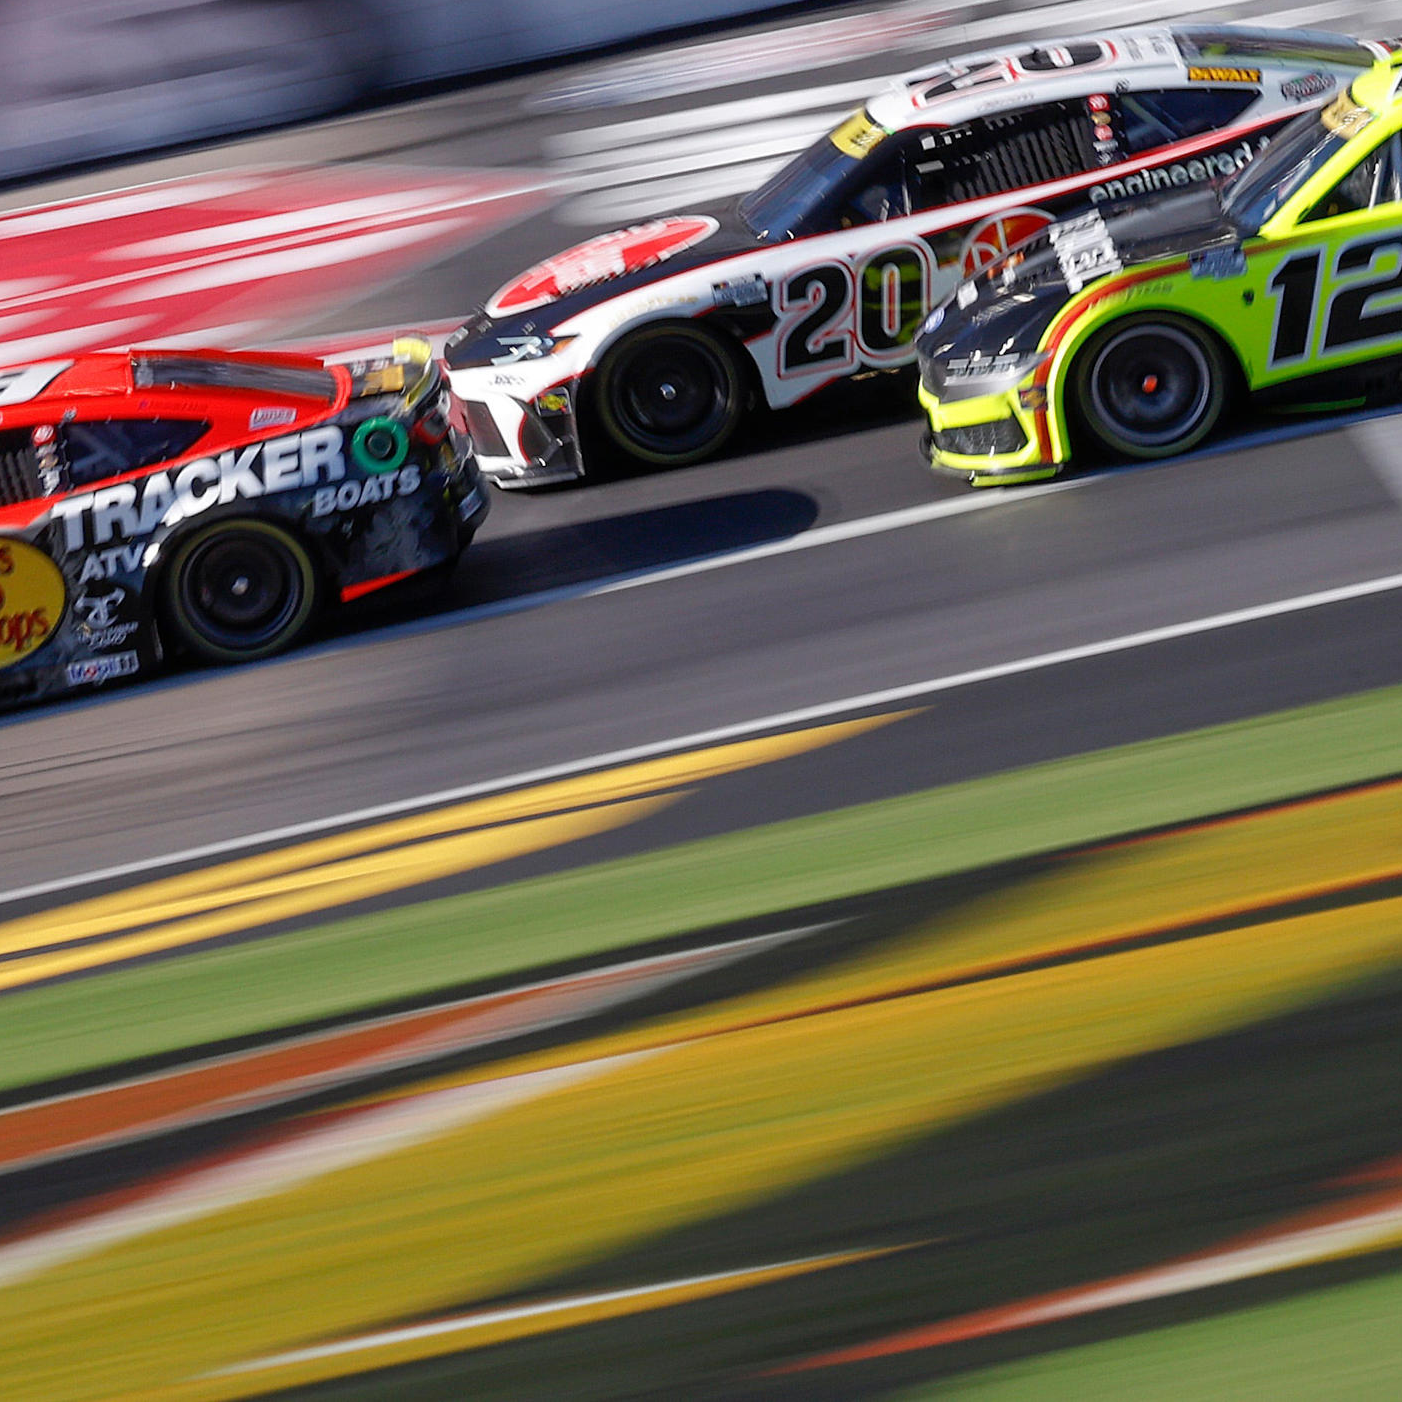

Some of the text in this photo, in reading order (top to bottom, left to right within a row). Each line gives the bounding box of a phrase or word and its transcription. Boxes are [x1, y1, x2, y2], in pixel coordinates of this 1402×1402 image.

[778, 240, 932, 380] 20
[51, 426, 347, 554] TRACKER
[311, 464, 421, 518] BOATS
